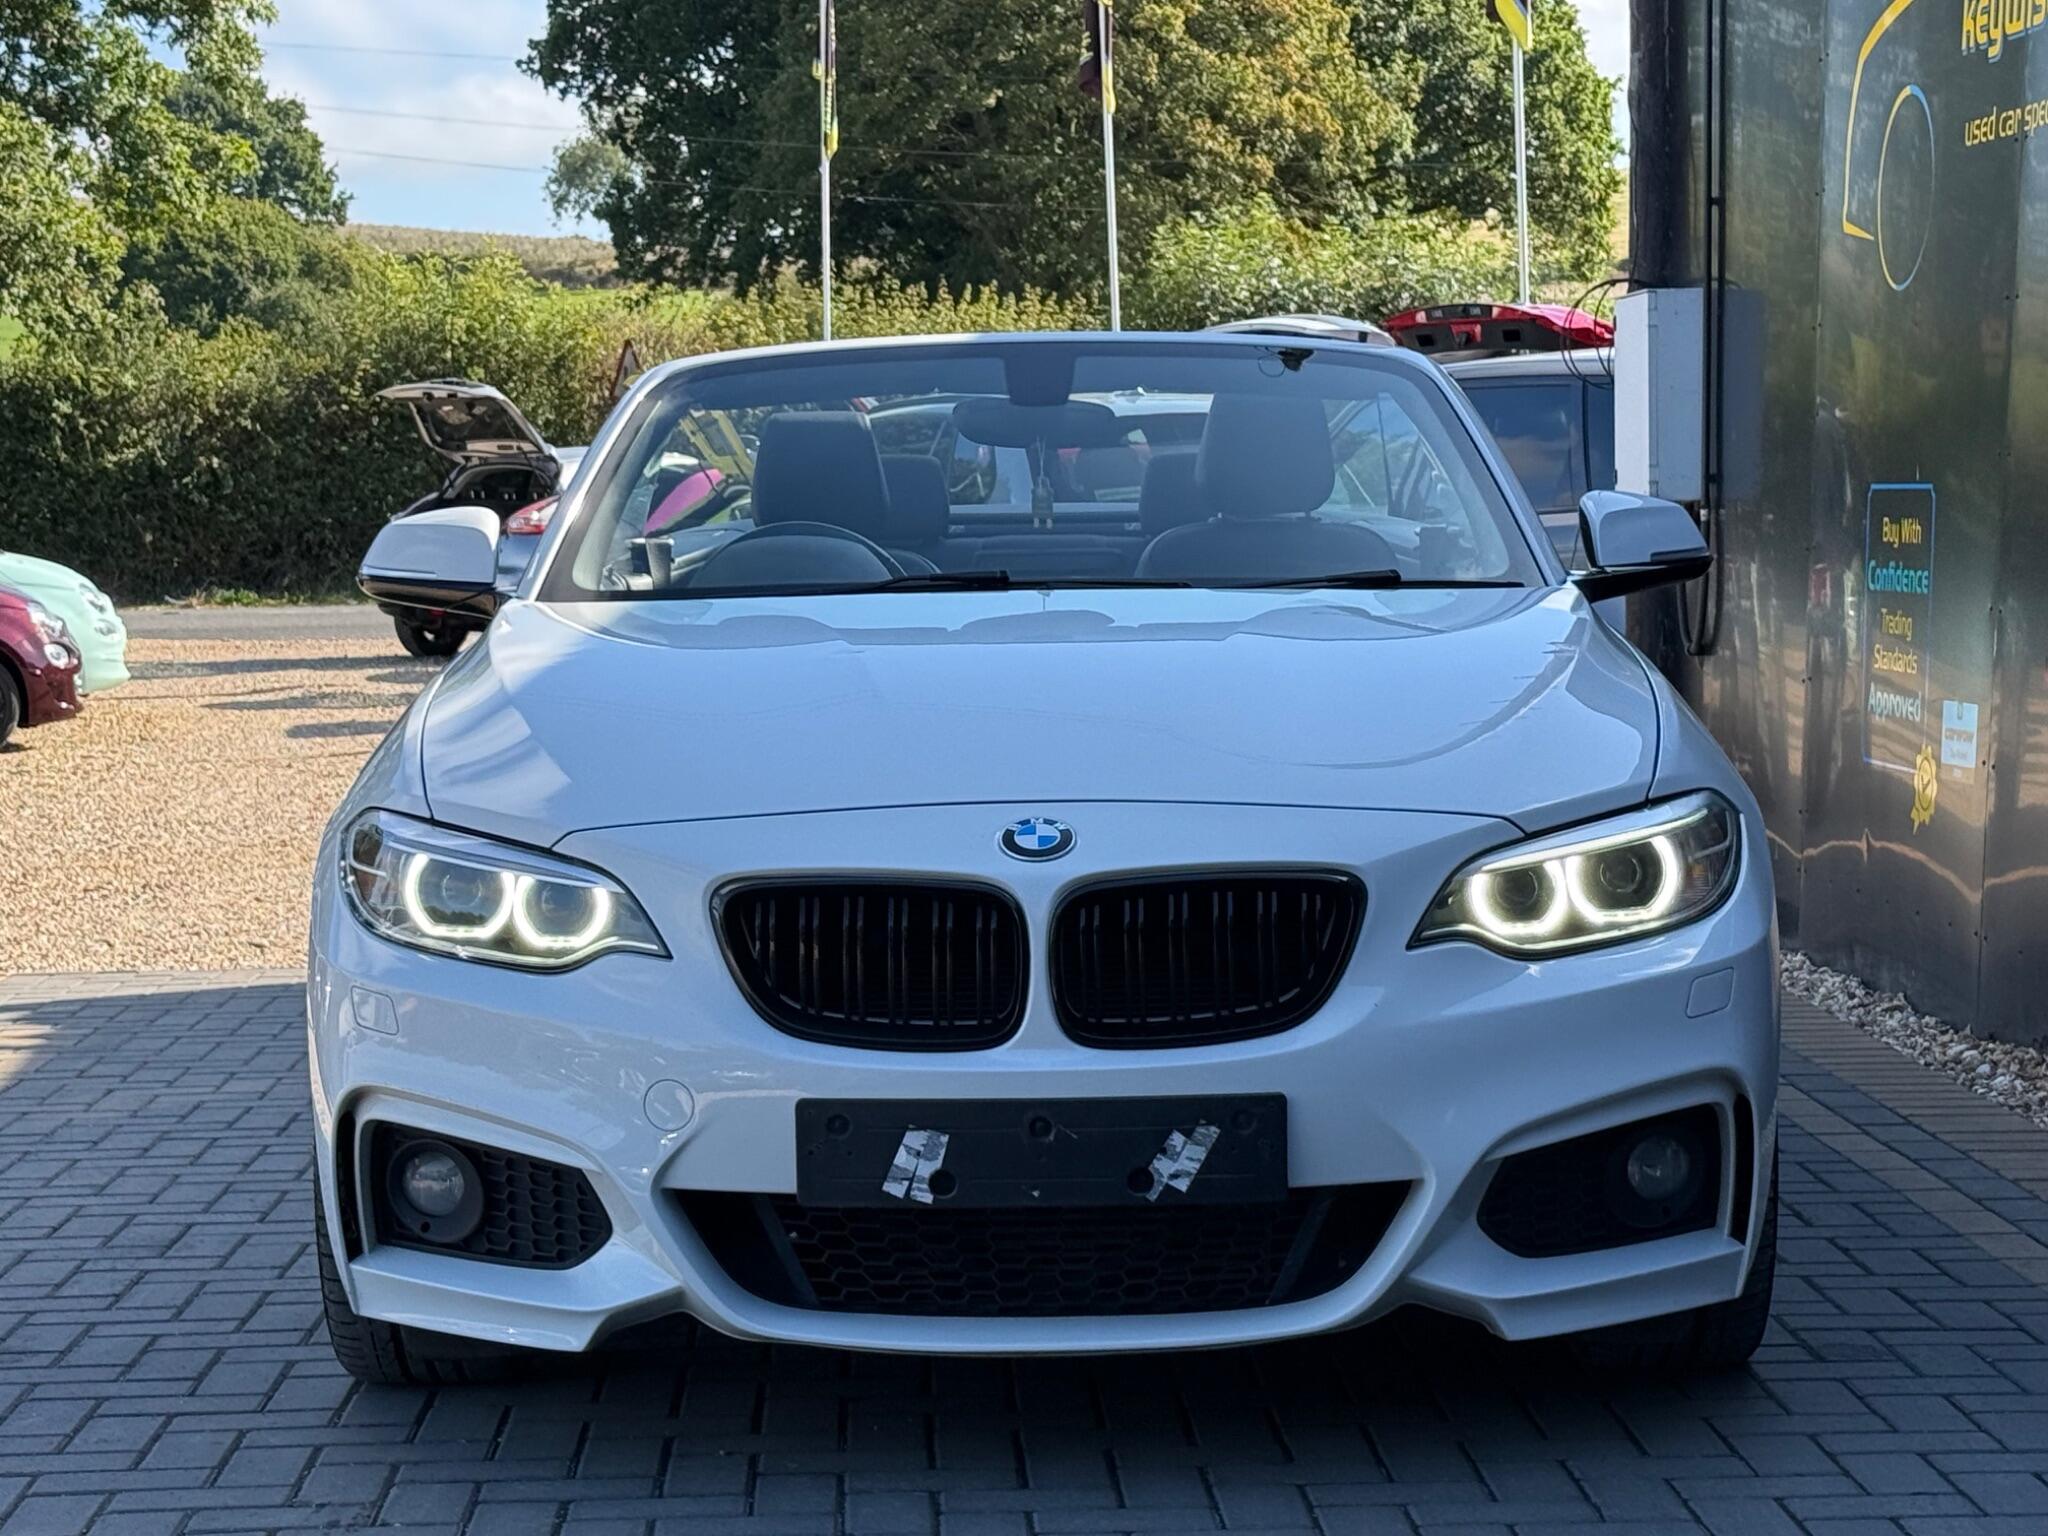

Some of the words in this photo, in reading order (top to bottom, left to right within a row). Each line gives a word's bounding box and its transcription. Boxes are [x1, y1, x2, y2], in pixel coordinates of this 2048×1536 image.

[1965, 105, 1997, 147] used
[1999, 107, 2022, 137] car
[1882, 516, 1900, 548] Buy
[1901, 517, 1922, 544] With
[1868, 560, 1929, 594] Confidence
[1881, 608, 1913, 641] Trading
[1873, 644, 1918, 674] Standards
[1868, 681, 1921, 722] Approved
